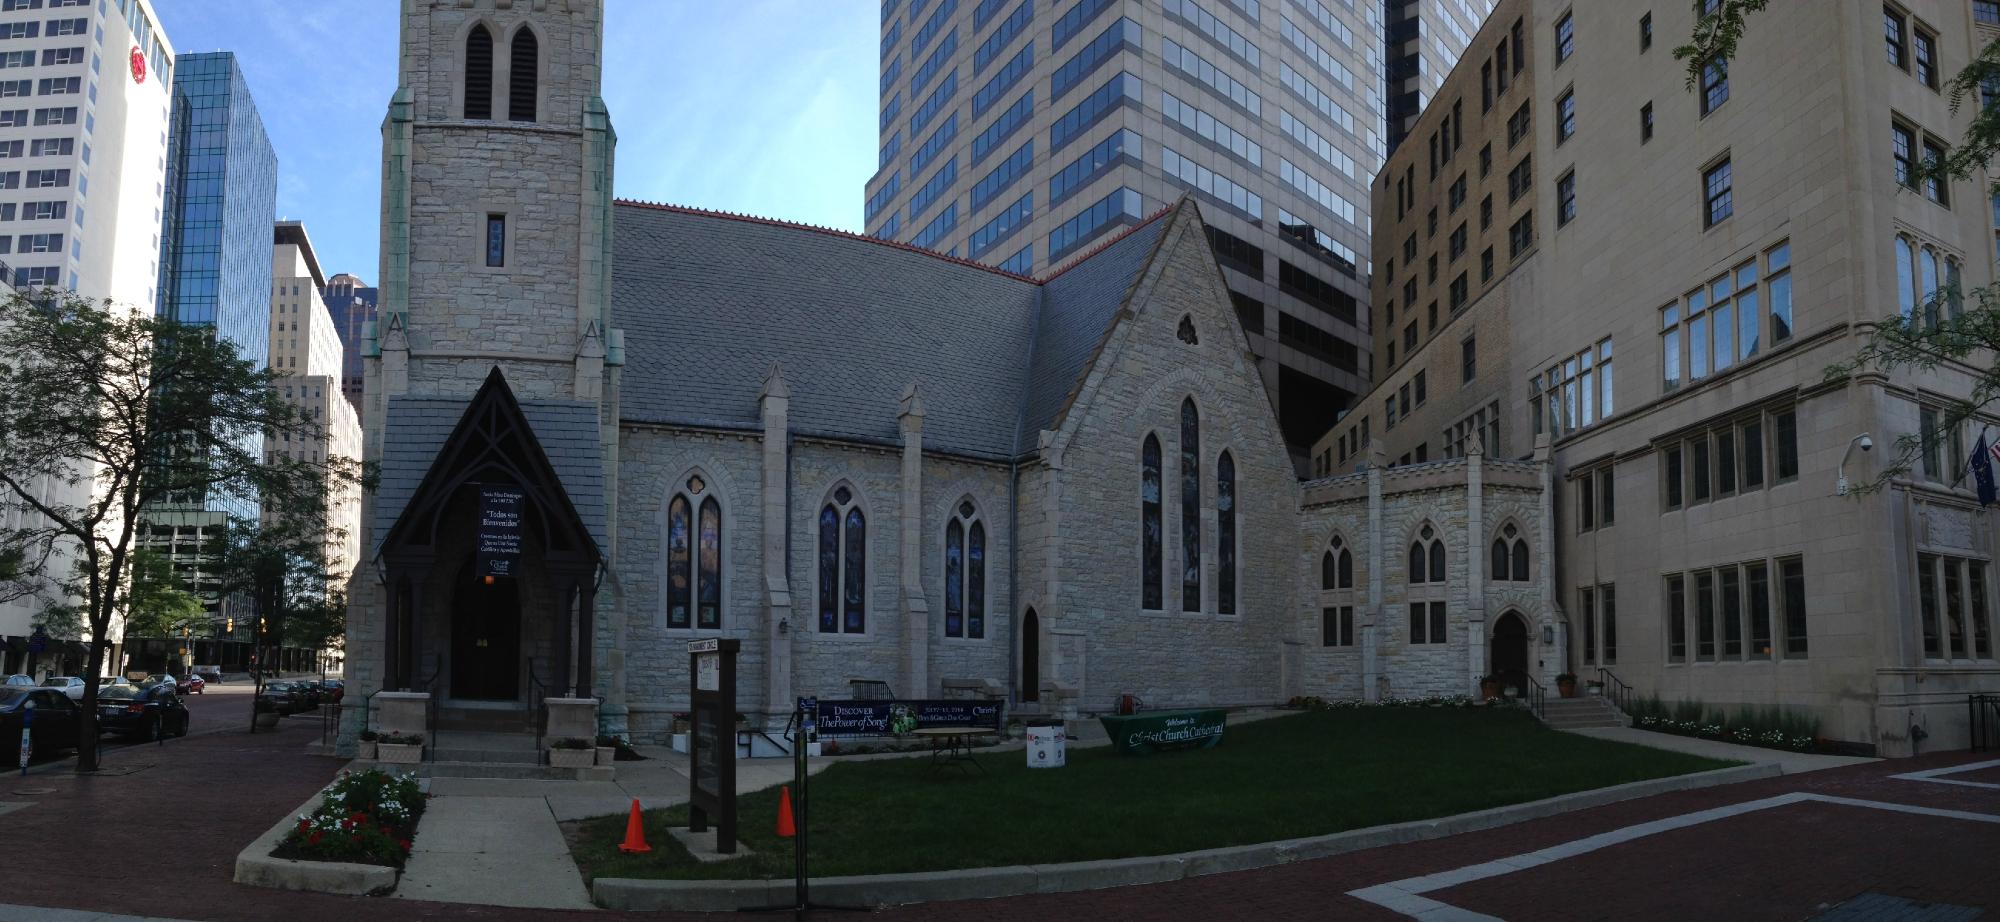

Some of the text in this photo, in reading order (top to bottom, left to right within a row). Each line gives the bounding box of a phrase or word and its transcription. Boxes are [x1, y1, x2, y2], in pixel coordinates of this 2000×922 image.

[820, 714, 888, 730] The Power of Song!
[1165, 718, 1188, 726] Welcome
[1129, 722, 1224, 744] Christ Church Cathedral
